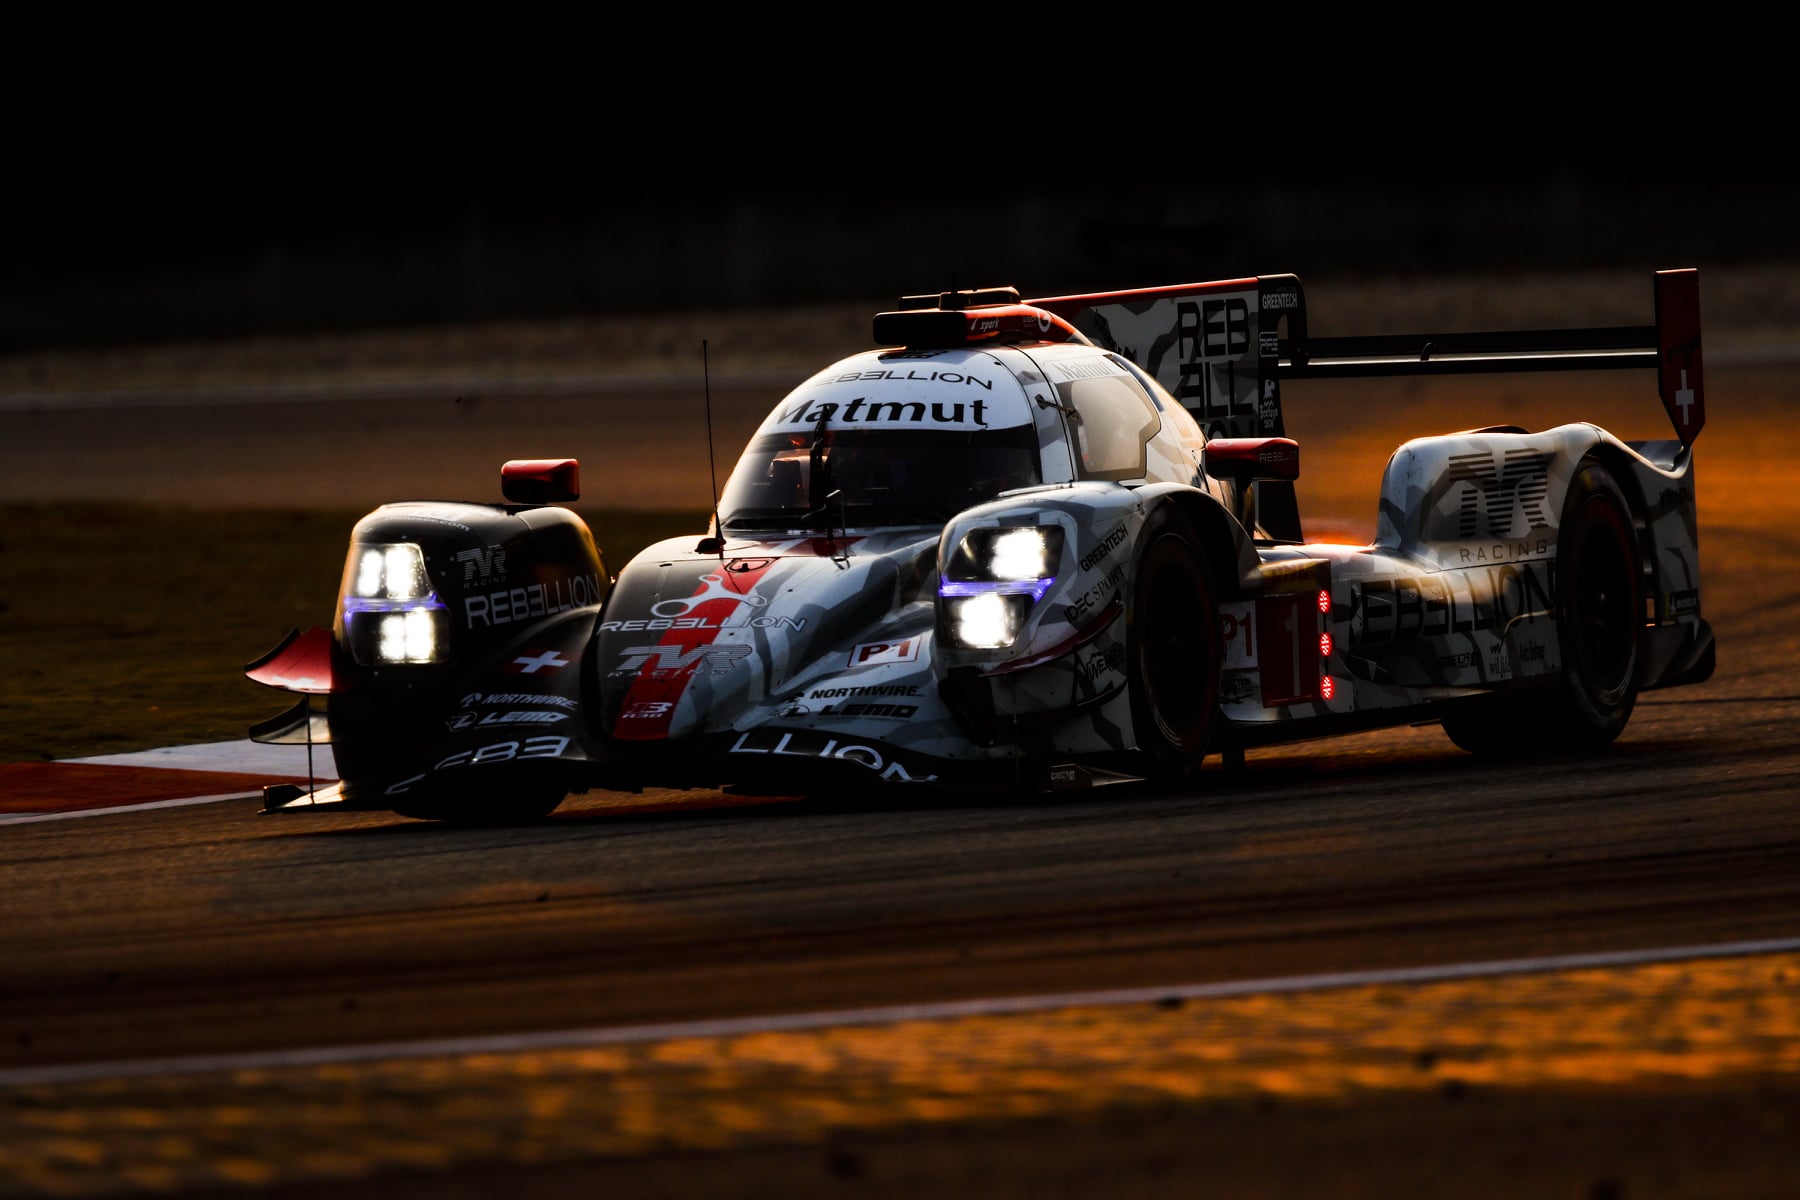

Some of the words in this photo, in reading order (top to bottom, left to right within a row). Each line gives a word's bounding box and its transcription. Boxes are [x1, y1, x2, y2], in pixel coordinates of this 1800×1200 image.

[1262, 292, 1298, 310] GREENTECH
[979, 316, 1000, 332] spark
[1177, 298, 1250, 359] REB
[816, 370, 993, 391] EBELLION
[1080, 523, 1129, 573] GREENTECH
[1459, 539, 1548, 563] RACING
[463, 576, 508, 590] RACING
[464, 573, 602, 630] REBELLION
[1064, 591, 1096, 625] IDEC
[1092, 563, 1126, 599] SPORT
[597, 616, 808, 636] REBELLION
[858, 640, 911, 662] P1
[1283, 600, 1300, 698] 1
[607, 667, 728, 681] RACING
[481, 692, 578, 711] NORTHWIRE
[811, 685, 924, 699] NORTHWIRE
[477, 711, 571, 726] LEMO
[818, 703, 919, 718] LEMO
